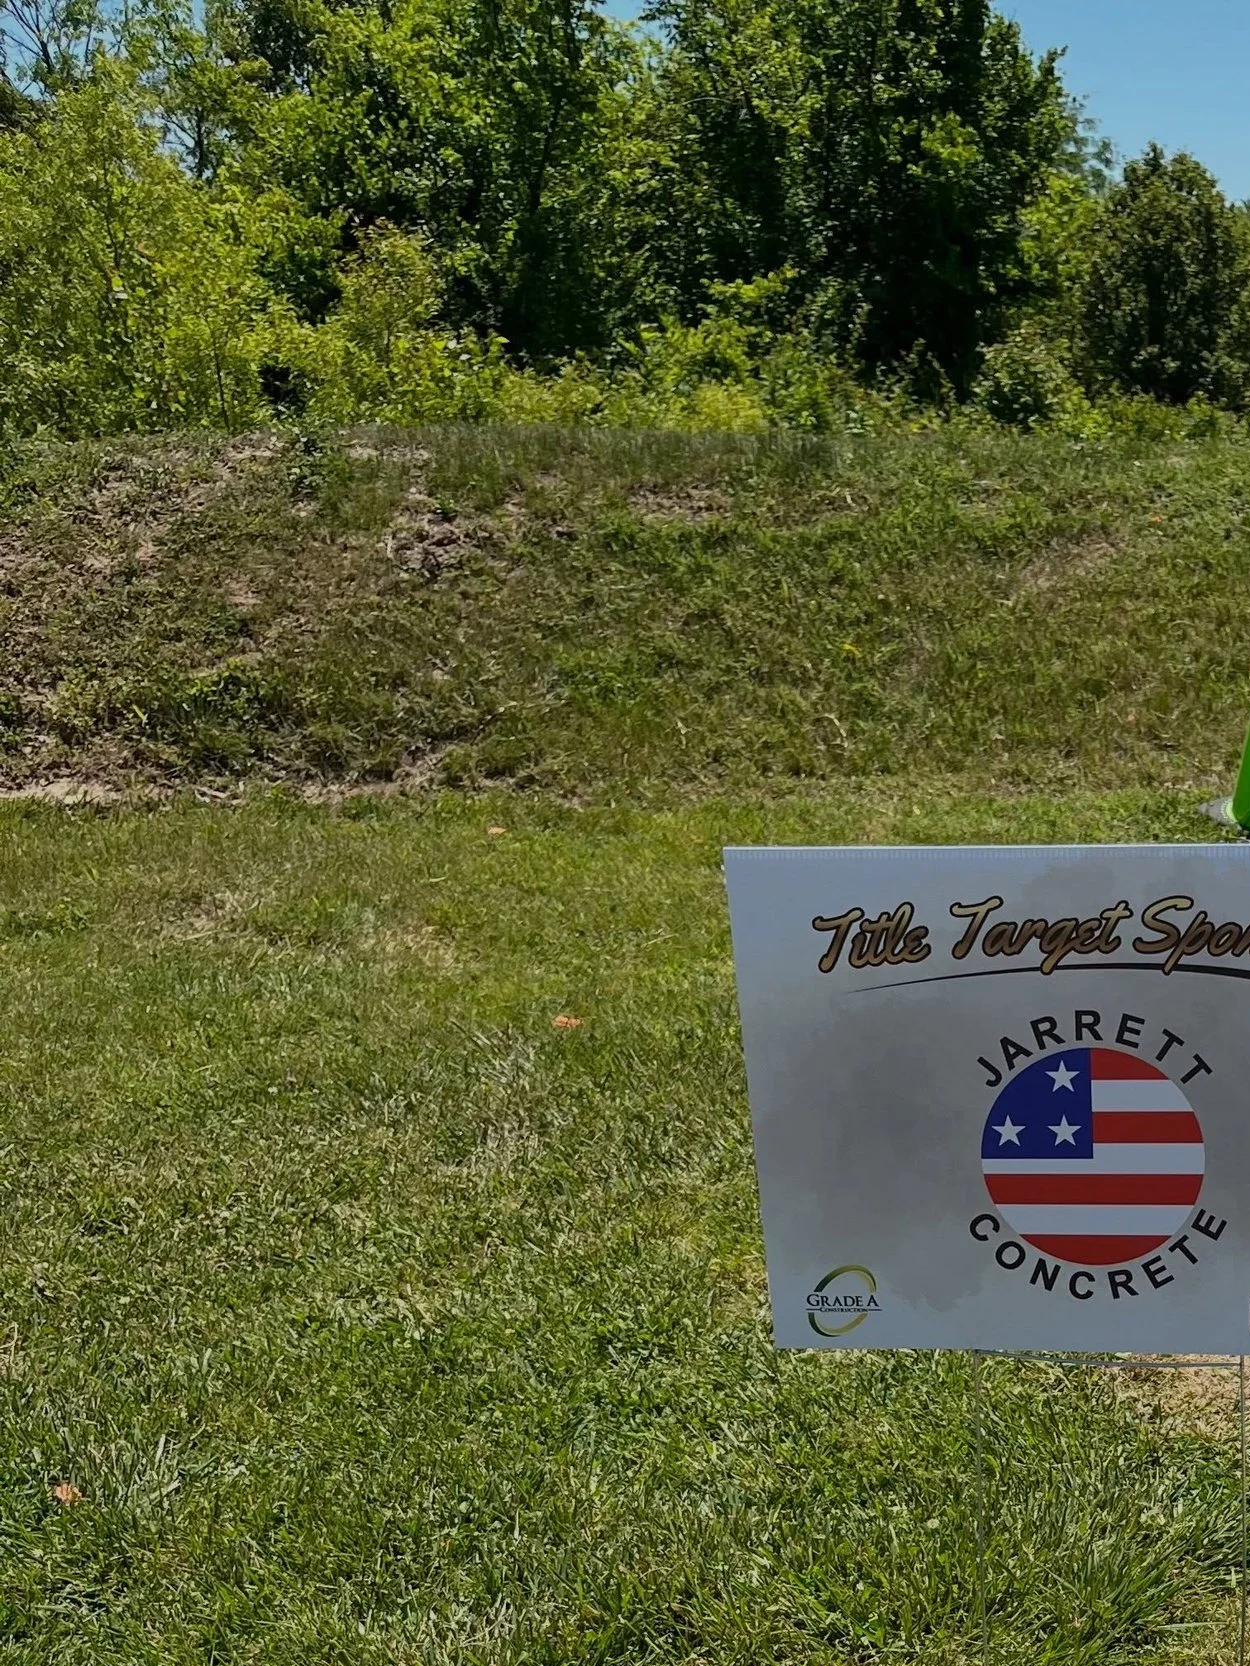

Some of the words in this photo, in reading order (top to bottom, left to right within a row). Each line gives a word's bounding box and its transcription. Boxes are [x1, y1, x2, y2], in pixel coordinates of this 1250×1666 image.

[812, 901, 932, 973] Title
[949, 895, 1134, 976] Target
[976, 1009, 1214, 1088] JARRETT
[968, 1207, 1228, 1301] CONCRETE
[806, 1293, 863, 1307] GRADE
[866, 1294, 880, 1307] A
